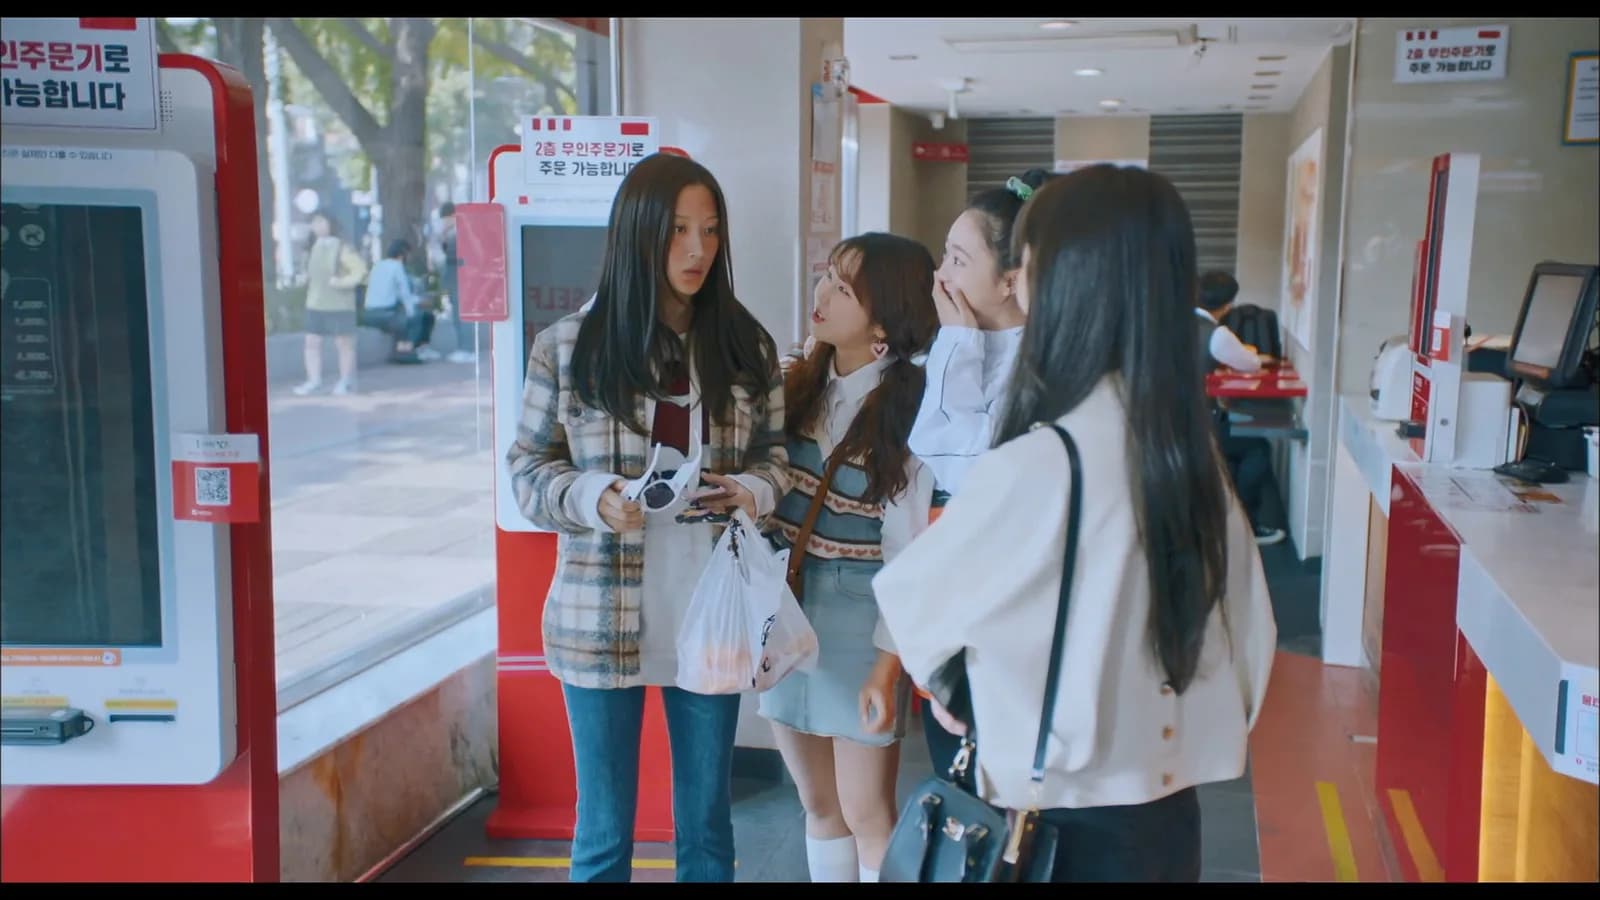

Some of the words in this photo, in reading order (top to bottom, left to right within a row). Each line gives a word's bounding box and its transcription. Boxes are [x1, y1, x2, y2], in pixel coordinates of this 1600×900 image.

[1406, 48, 1423, 60] 2층
[1428, 44, 1496, 59] 무인주문기로
[1409, 62, 1431, 75] 주문
[1436, 59, 1492, 73] 가능합니다
[535, 142, 557, 157] 2층
[562, 142, 645, 157] 무인주문기로
[539, 161, 567, 176] 주문
